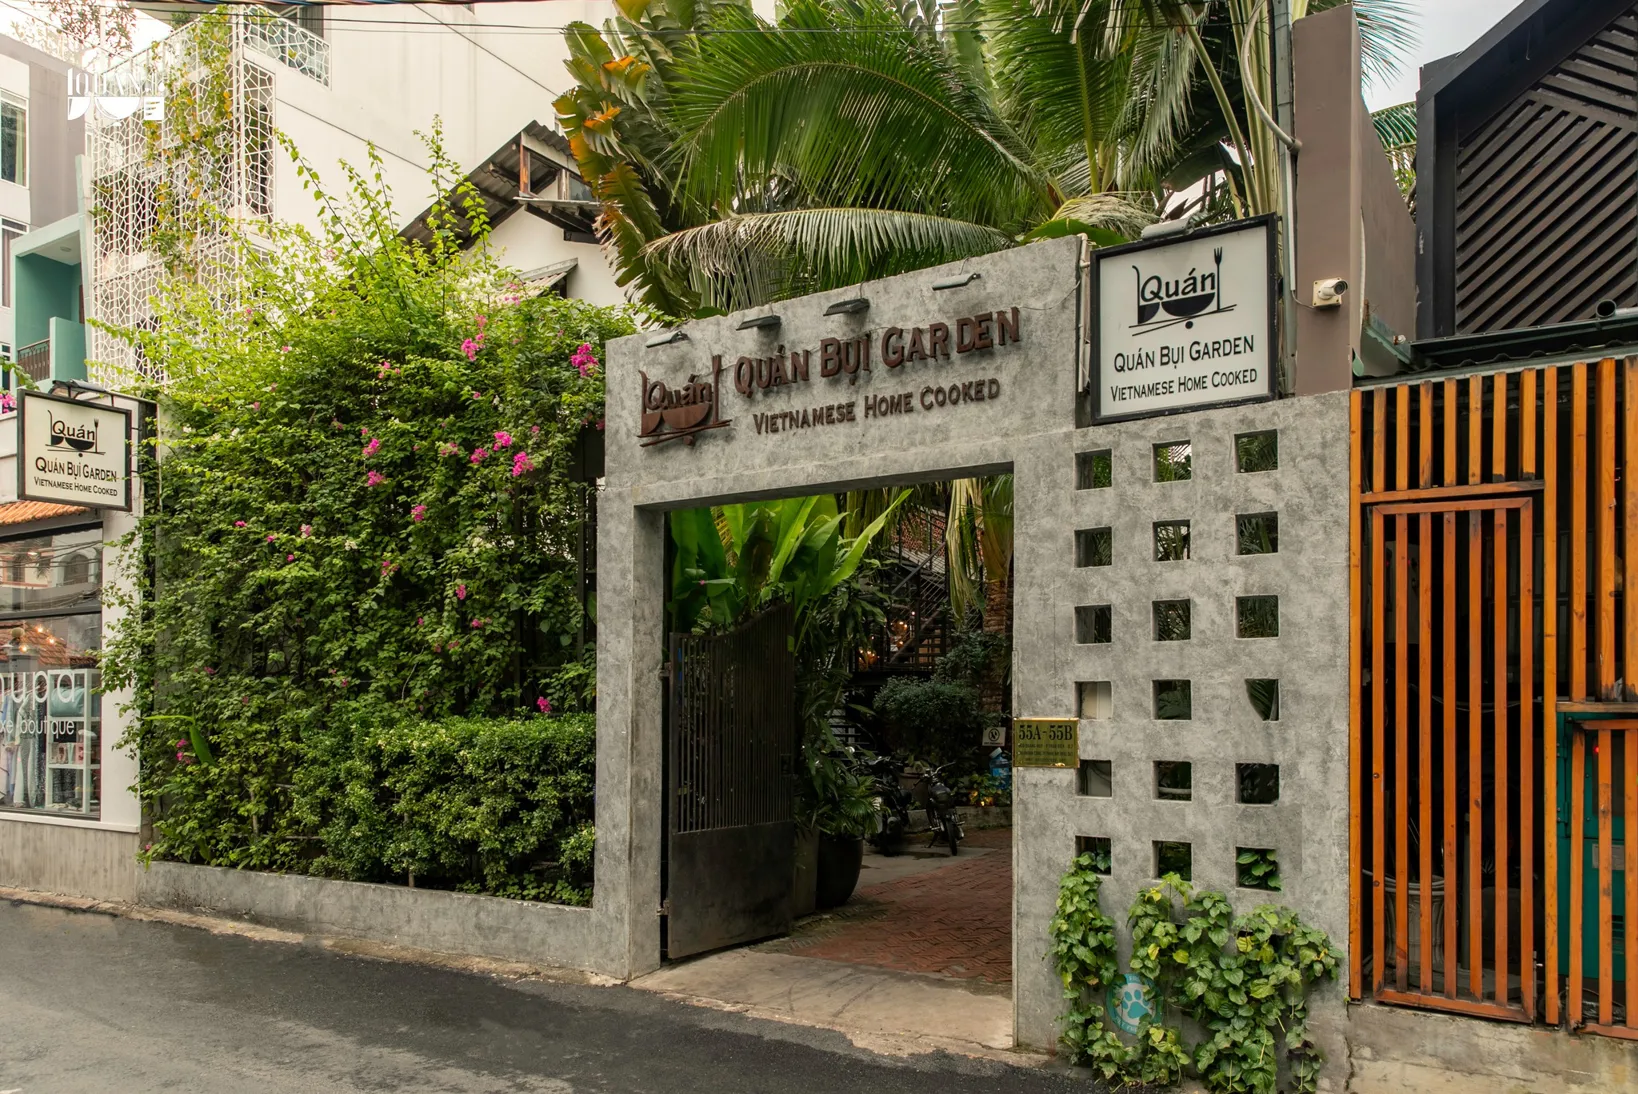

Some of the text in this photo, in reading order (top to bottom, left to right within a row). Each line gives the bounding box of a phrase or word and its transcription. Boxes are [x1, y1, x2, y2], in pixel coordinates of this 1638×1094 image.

[1141, 268, 1216, 302] Quán
[734, 344, 811, 398] QUÁN
[881, 307, 1021, 369] GARDEN
[1114, 347, 1155, 373] QUÁN
[1189, 335, 1255, 361] GARDEN
[645, 374, 714, 411] Quán
[1110, 368, 1258, 401] VIETNAMESE HOME COOKED
[752, 378, 1001, 435] VIETNAMESE HOME COOKED
[52, 420, 96, 441] Quán
[35, 456, 65, 475] QUÁN
[82, 464, 117, 482] GARDEN
[34, 476, 118, 497] VIETNAMESE HOME COOKED
[19, 715, 75, 739] boutque
